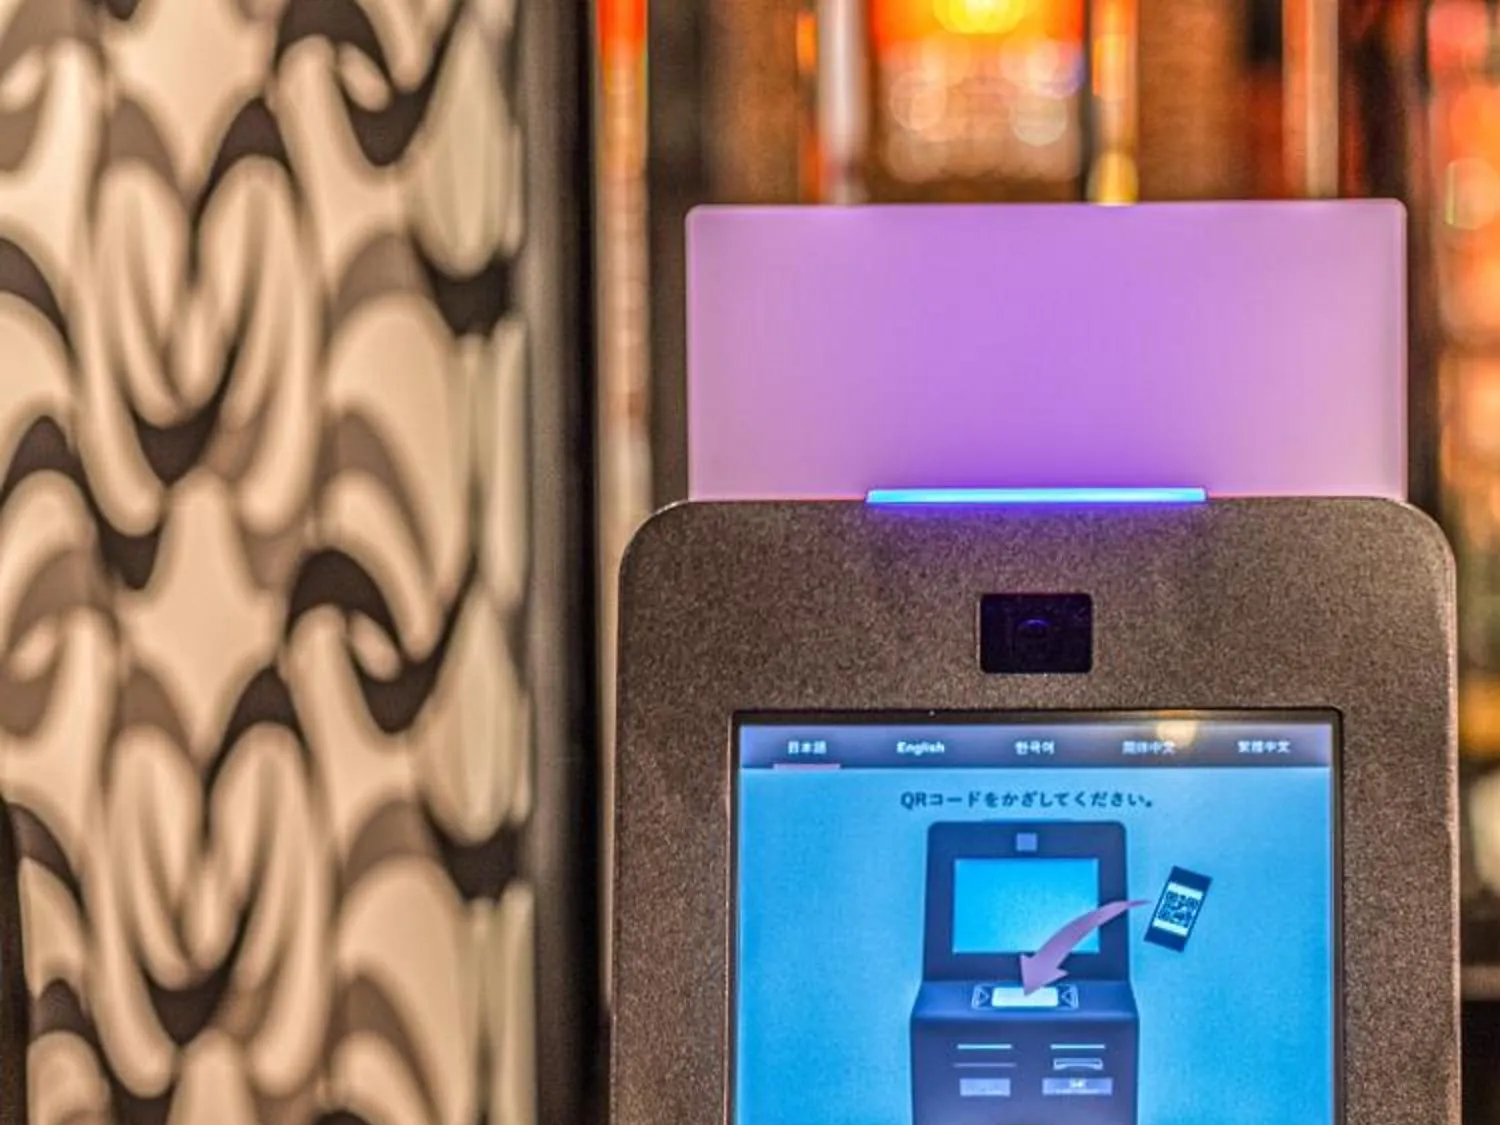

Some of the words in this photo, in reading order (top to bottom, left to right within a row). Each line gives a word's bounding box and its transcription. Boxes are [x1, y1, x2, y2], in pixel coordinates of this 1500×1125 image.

[896, 741, 946, 756] English
[1014, 740, 1055, 755] 한국어
[900, 791, 1153, 809] QRコードをかざしてください。
